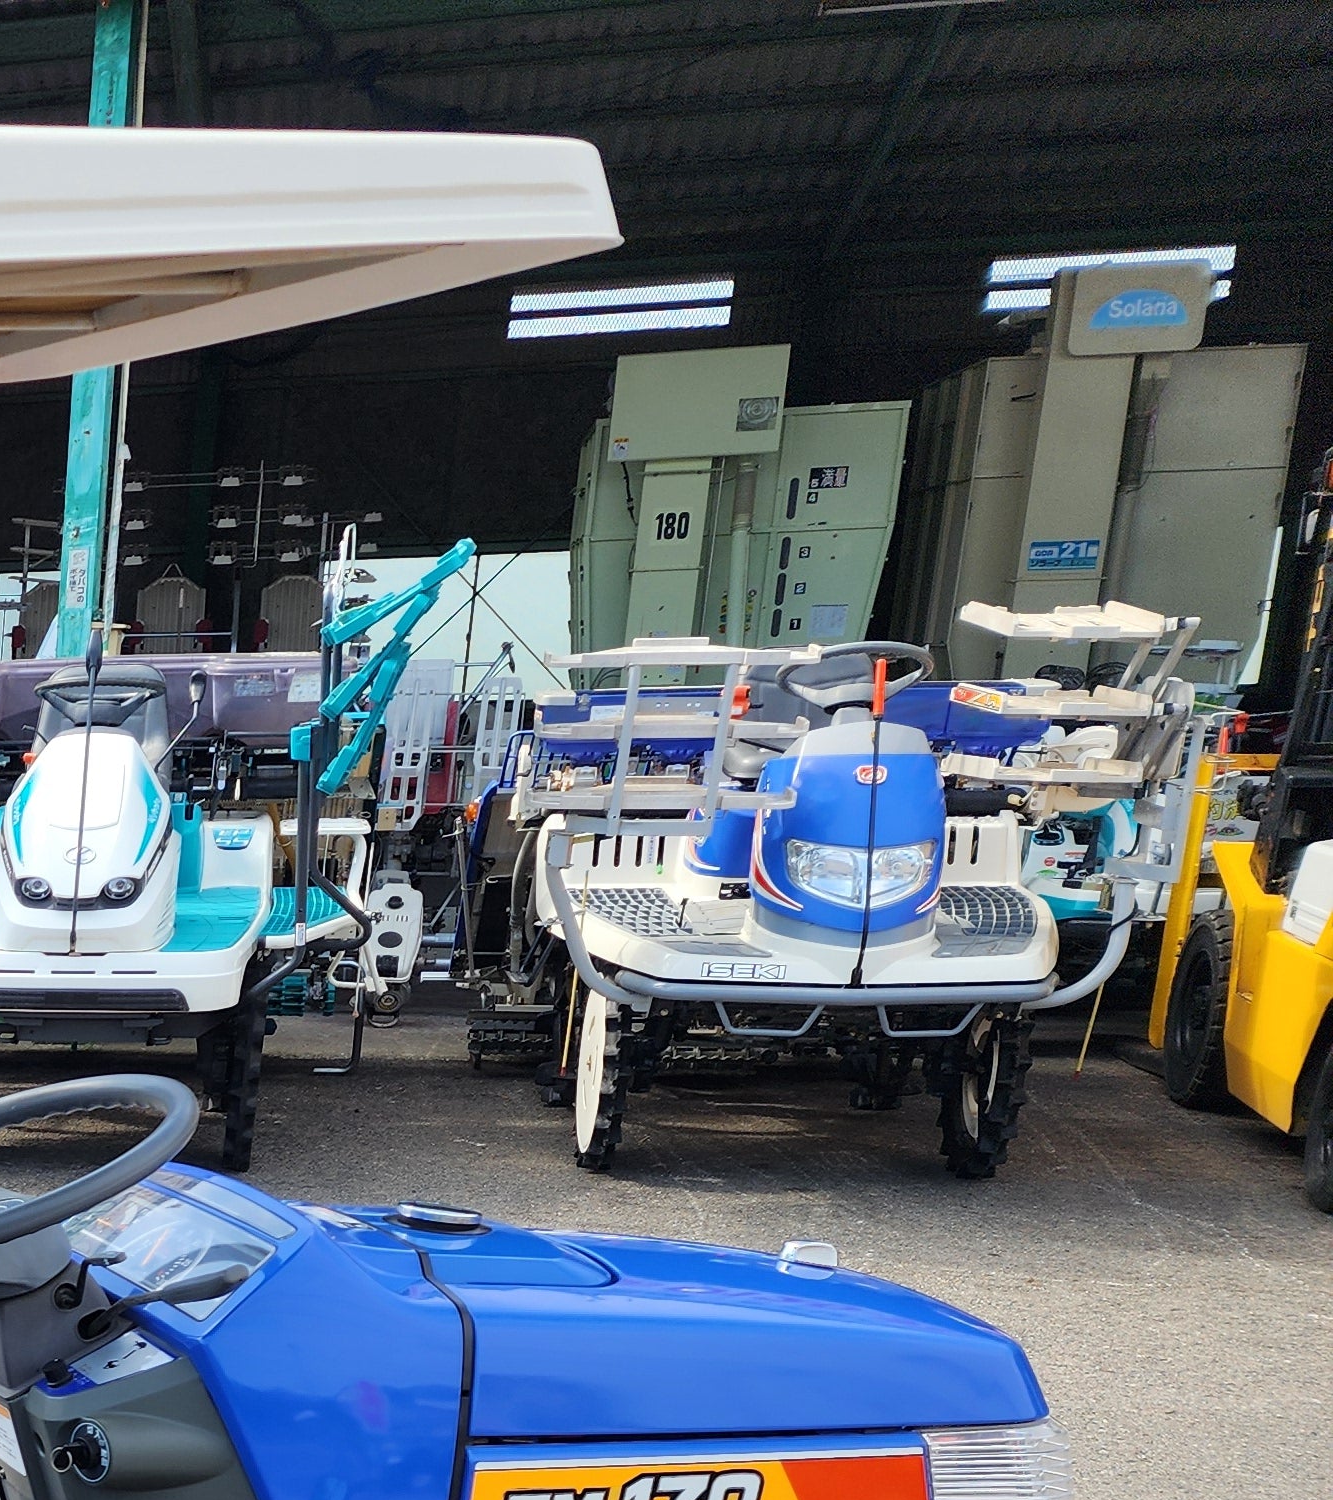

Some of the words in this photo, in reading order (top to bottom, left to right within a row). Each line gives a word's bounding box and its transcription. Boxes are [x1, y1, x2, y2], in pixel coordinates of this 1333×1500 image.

[1109, 299, 1178, 318] Solana
[821, 468, 848, 487] 満量
[808, 493, 816, 503] 4
[655, 511, 690, 540] 180
[801, 547, 809, 557] 3
[1061, 542, 1088, 558] 21
[796, 584, 805, 593] 2
[791, 620, 800, 629] 1
[701, 962, 787, 979] ISEKI
